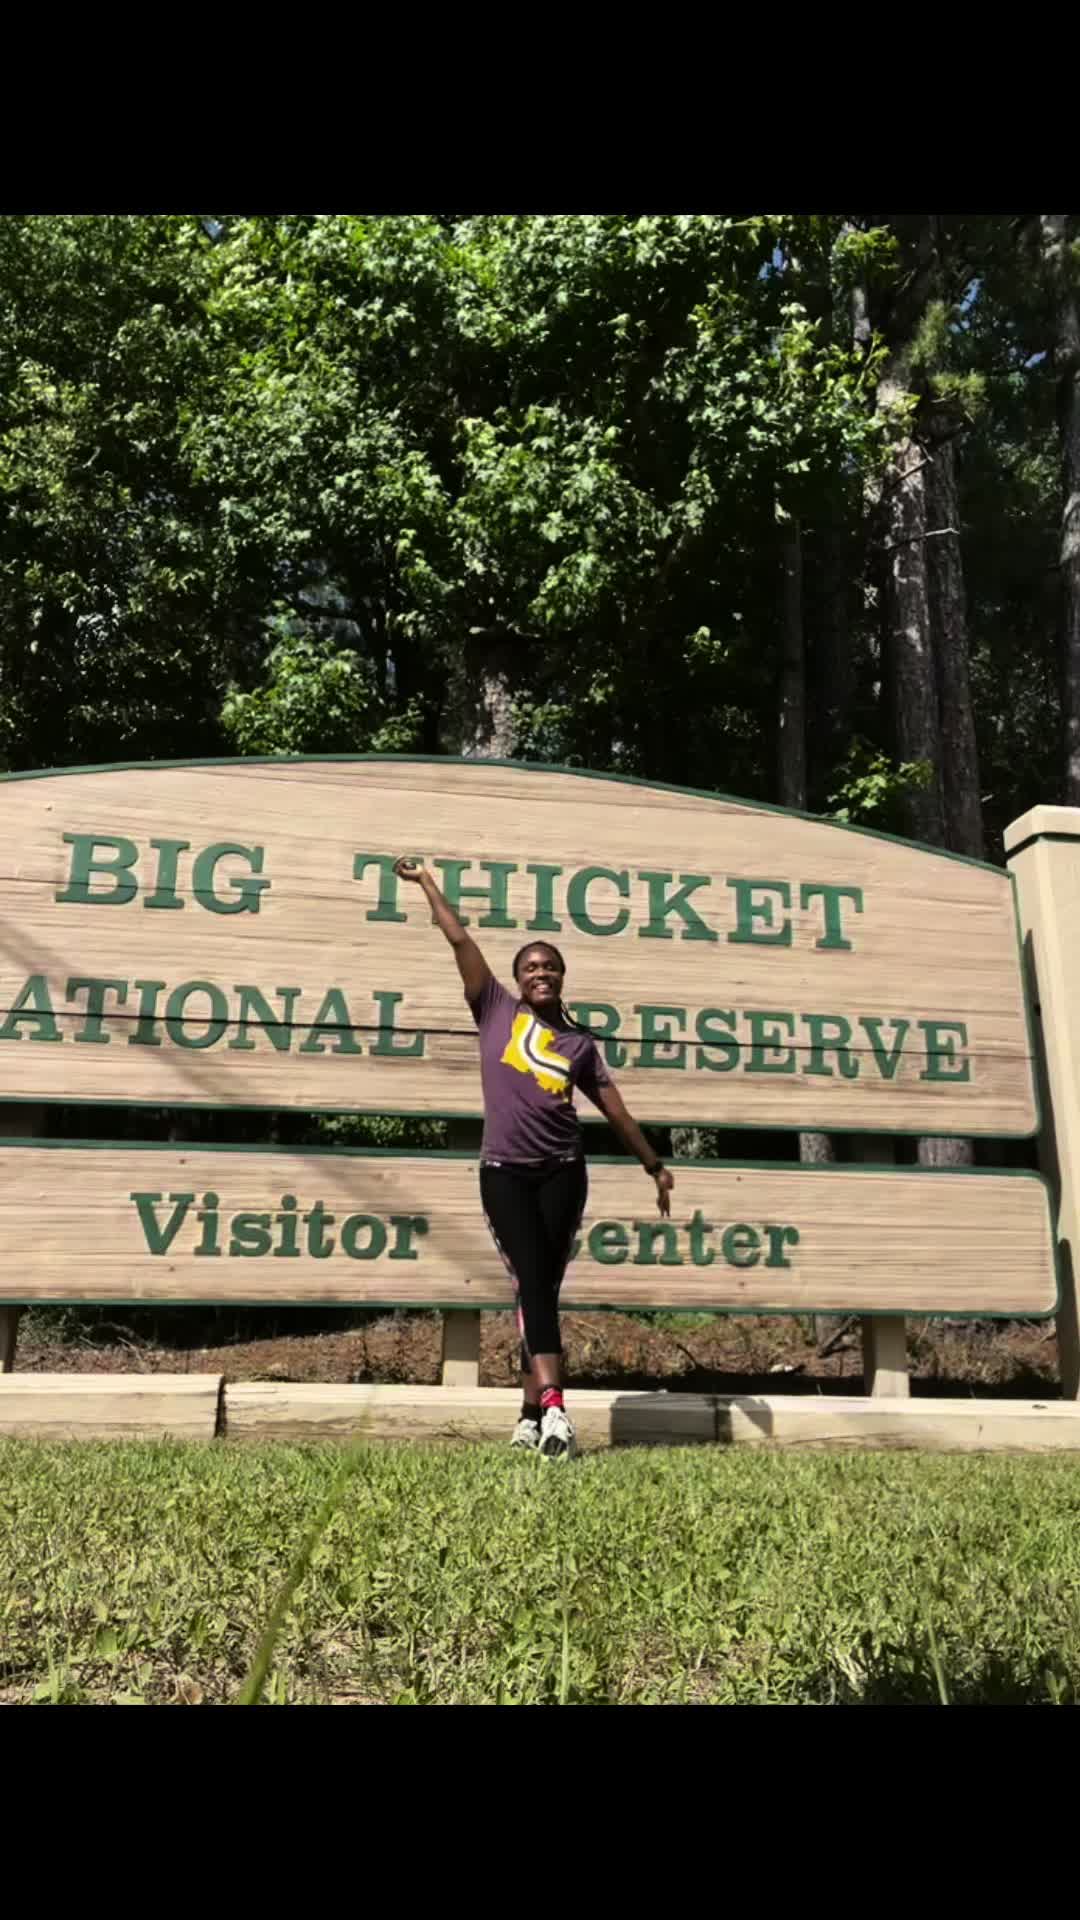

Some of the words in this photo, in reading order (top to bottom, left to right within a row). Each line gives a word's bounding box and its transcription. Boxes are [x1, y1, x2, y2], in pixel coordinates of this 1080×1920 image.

[55, 832, 271, 914] BIG
[353, 852, 864, 950] THICKET
[569, 1002, 972, 1082] RESERVE
[130, 1191, 430, 1260] Visitor
[569, 1208, 800, 1268] enter
